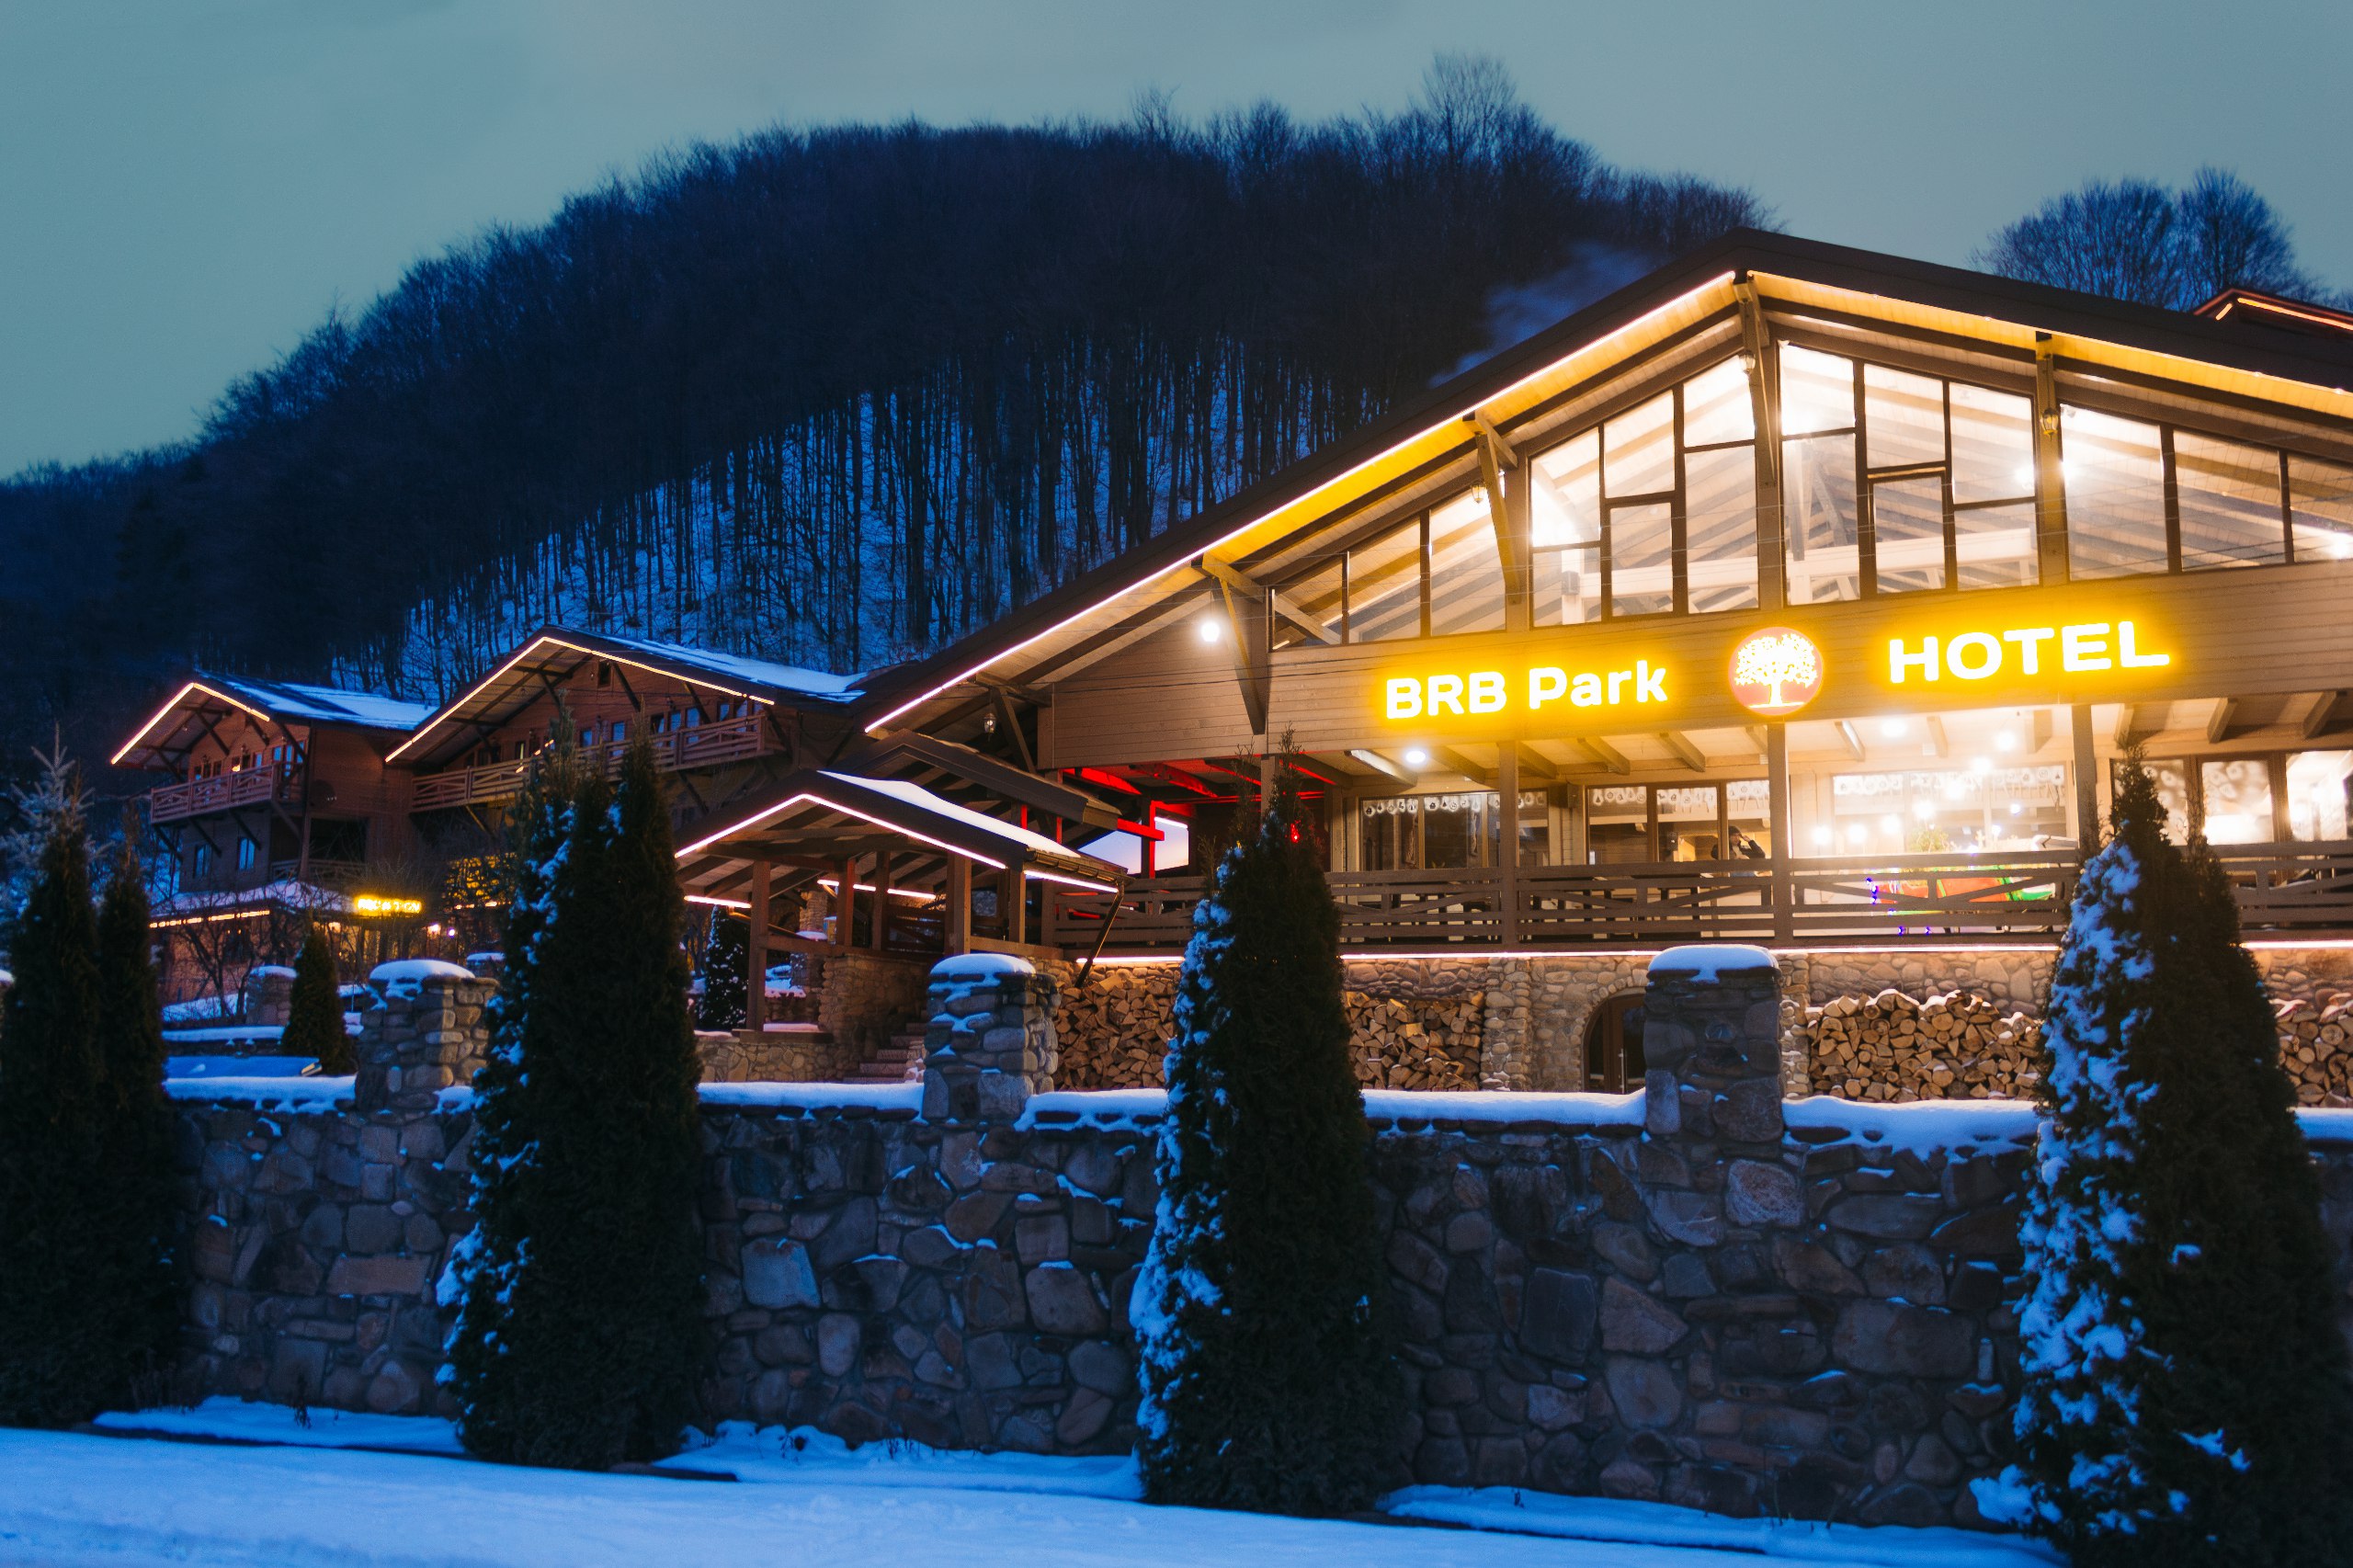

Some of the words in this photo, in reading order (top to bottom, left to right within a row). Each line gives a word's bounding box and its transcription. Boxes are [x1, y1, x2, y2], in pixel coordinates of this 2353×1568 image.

[1385, 670, 1507, 720] BRB
[1529, 659, 1669, 710] Park
[1889, 620, 2171, 684] HOTEL
